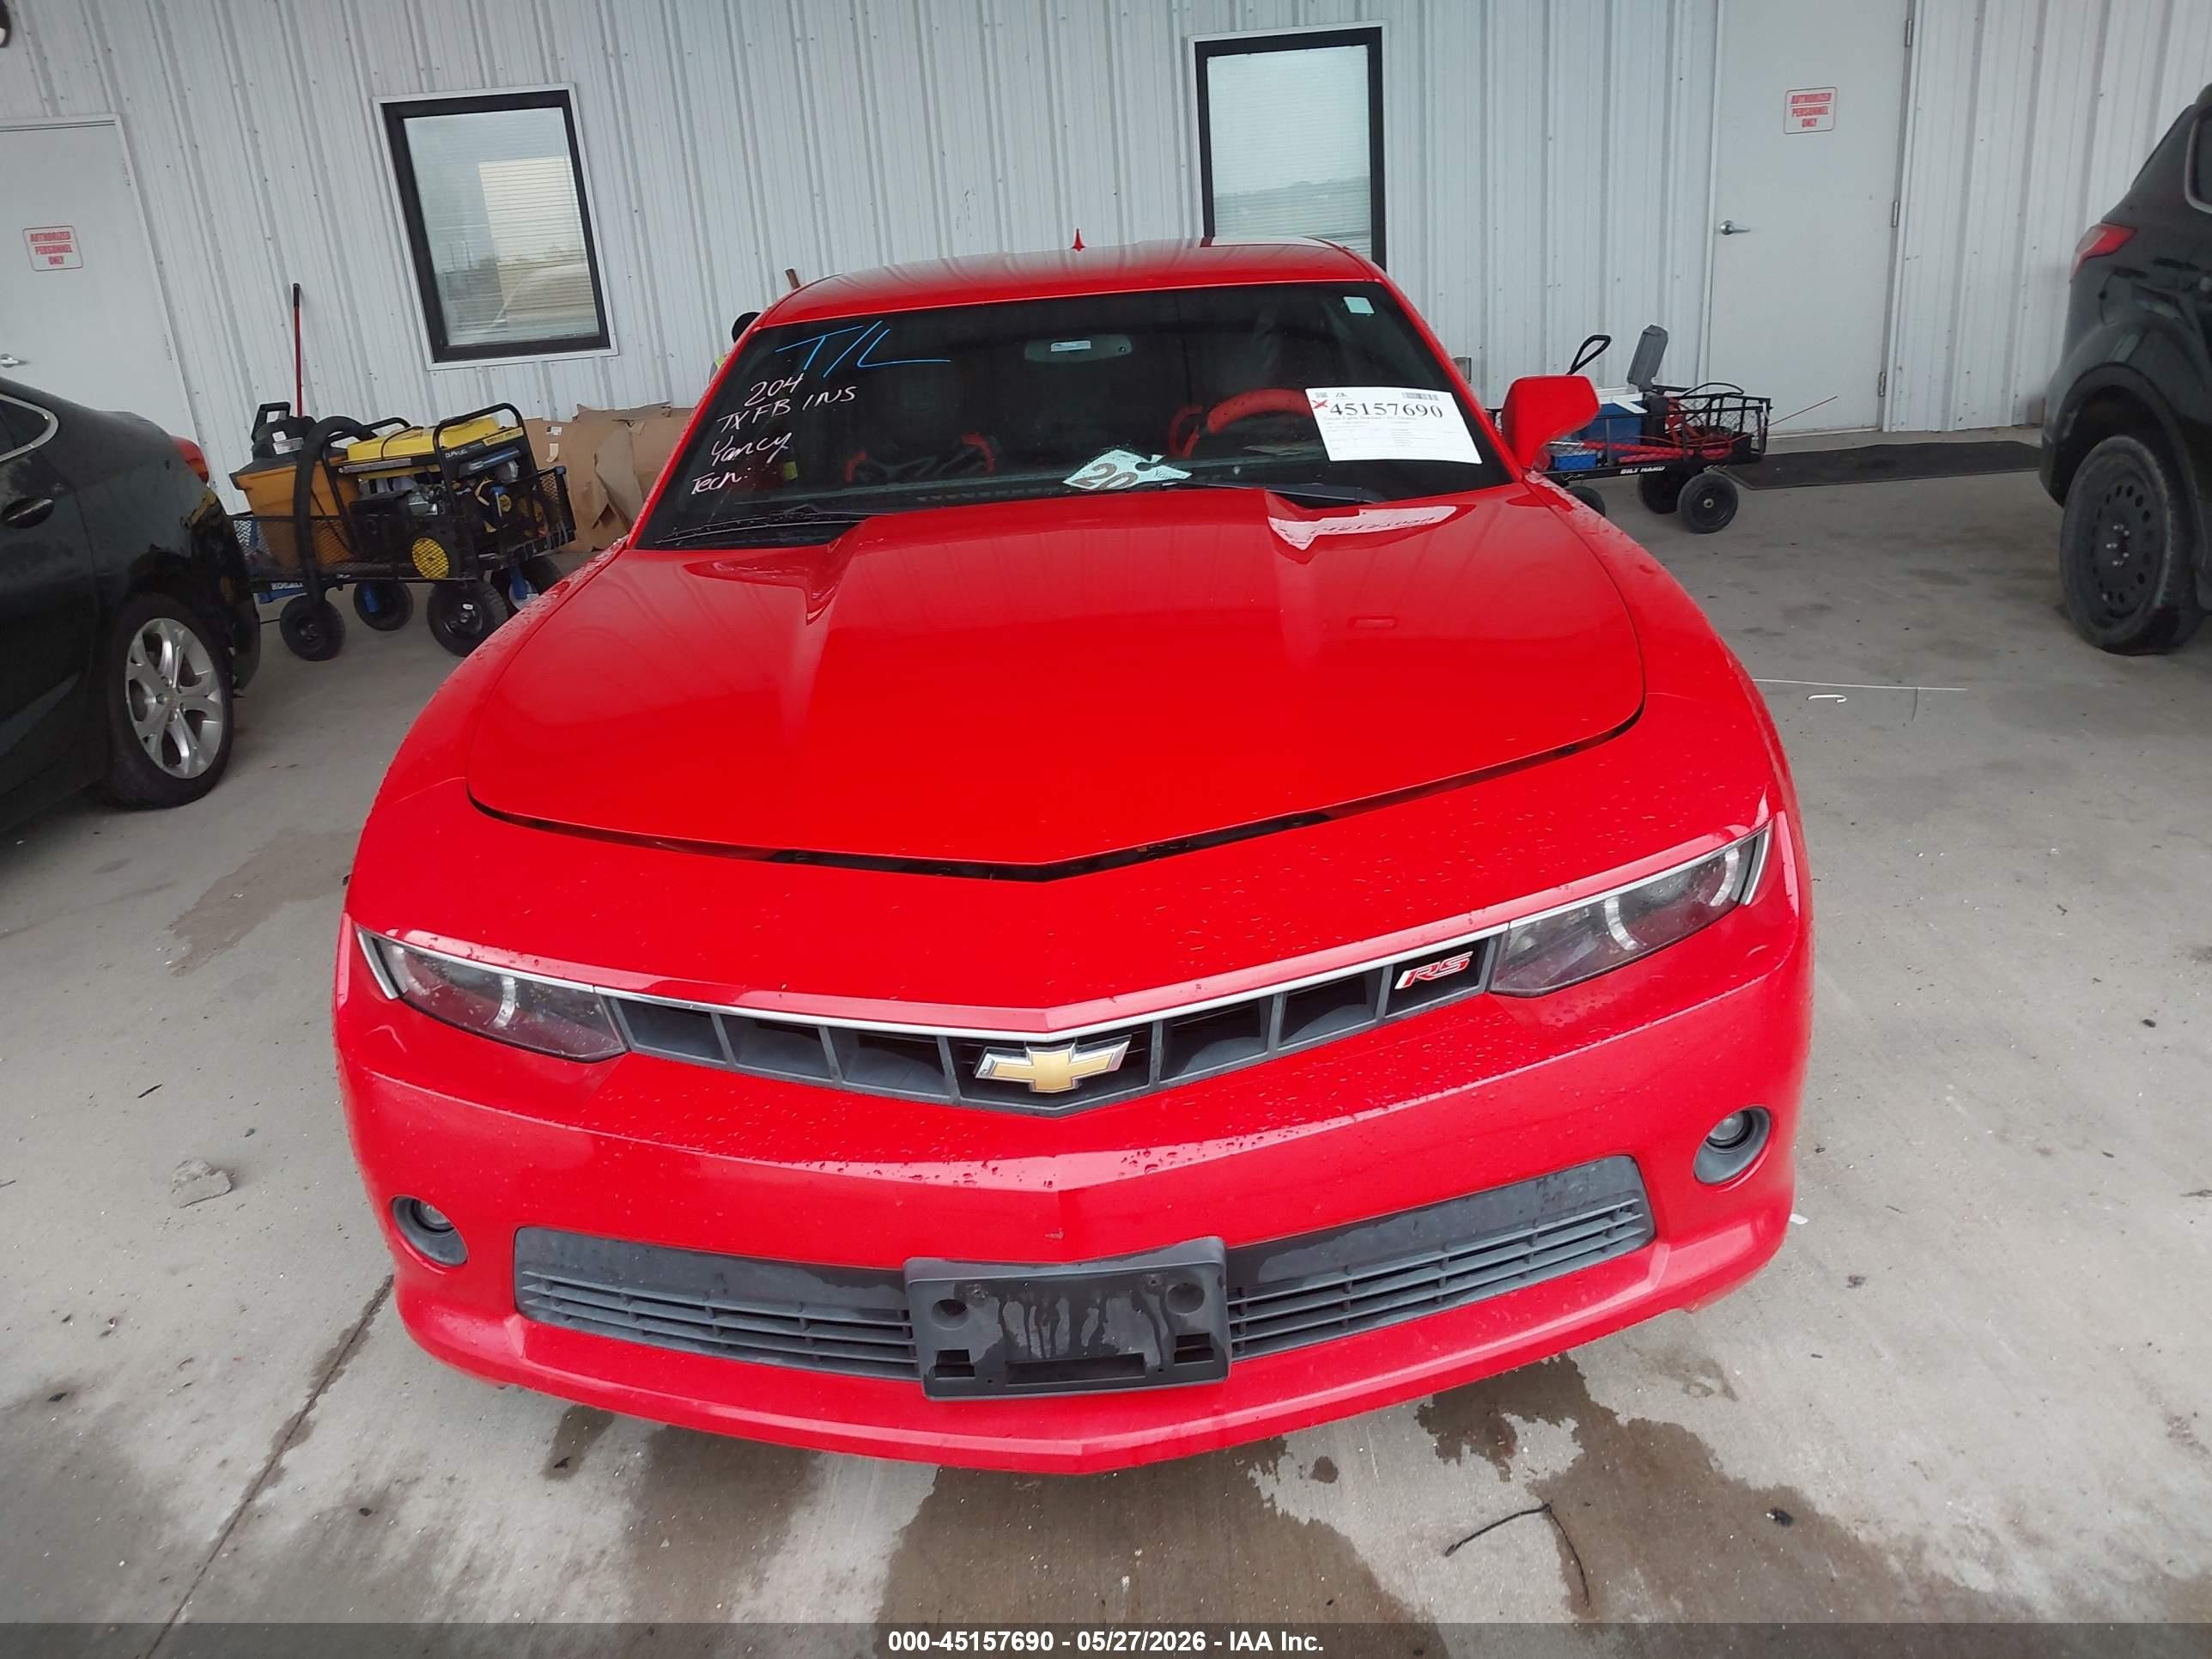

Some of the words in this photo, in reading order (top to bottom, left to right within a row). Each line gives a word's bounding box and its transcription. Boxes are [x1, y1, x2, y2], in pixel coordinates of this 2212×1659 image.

[744, 373, 804, 407] 204
[802, 386, 859, 411] INS
[1330, 403, 1443, 418] 45157690
[1395, 951, 1474, 989] RS
